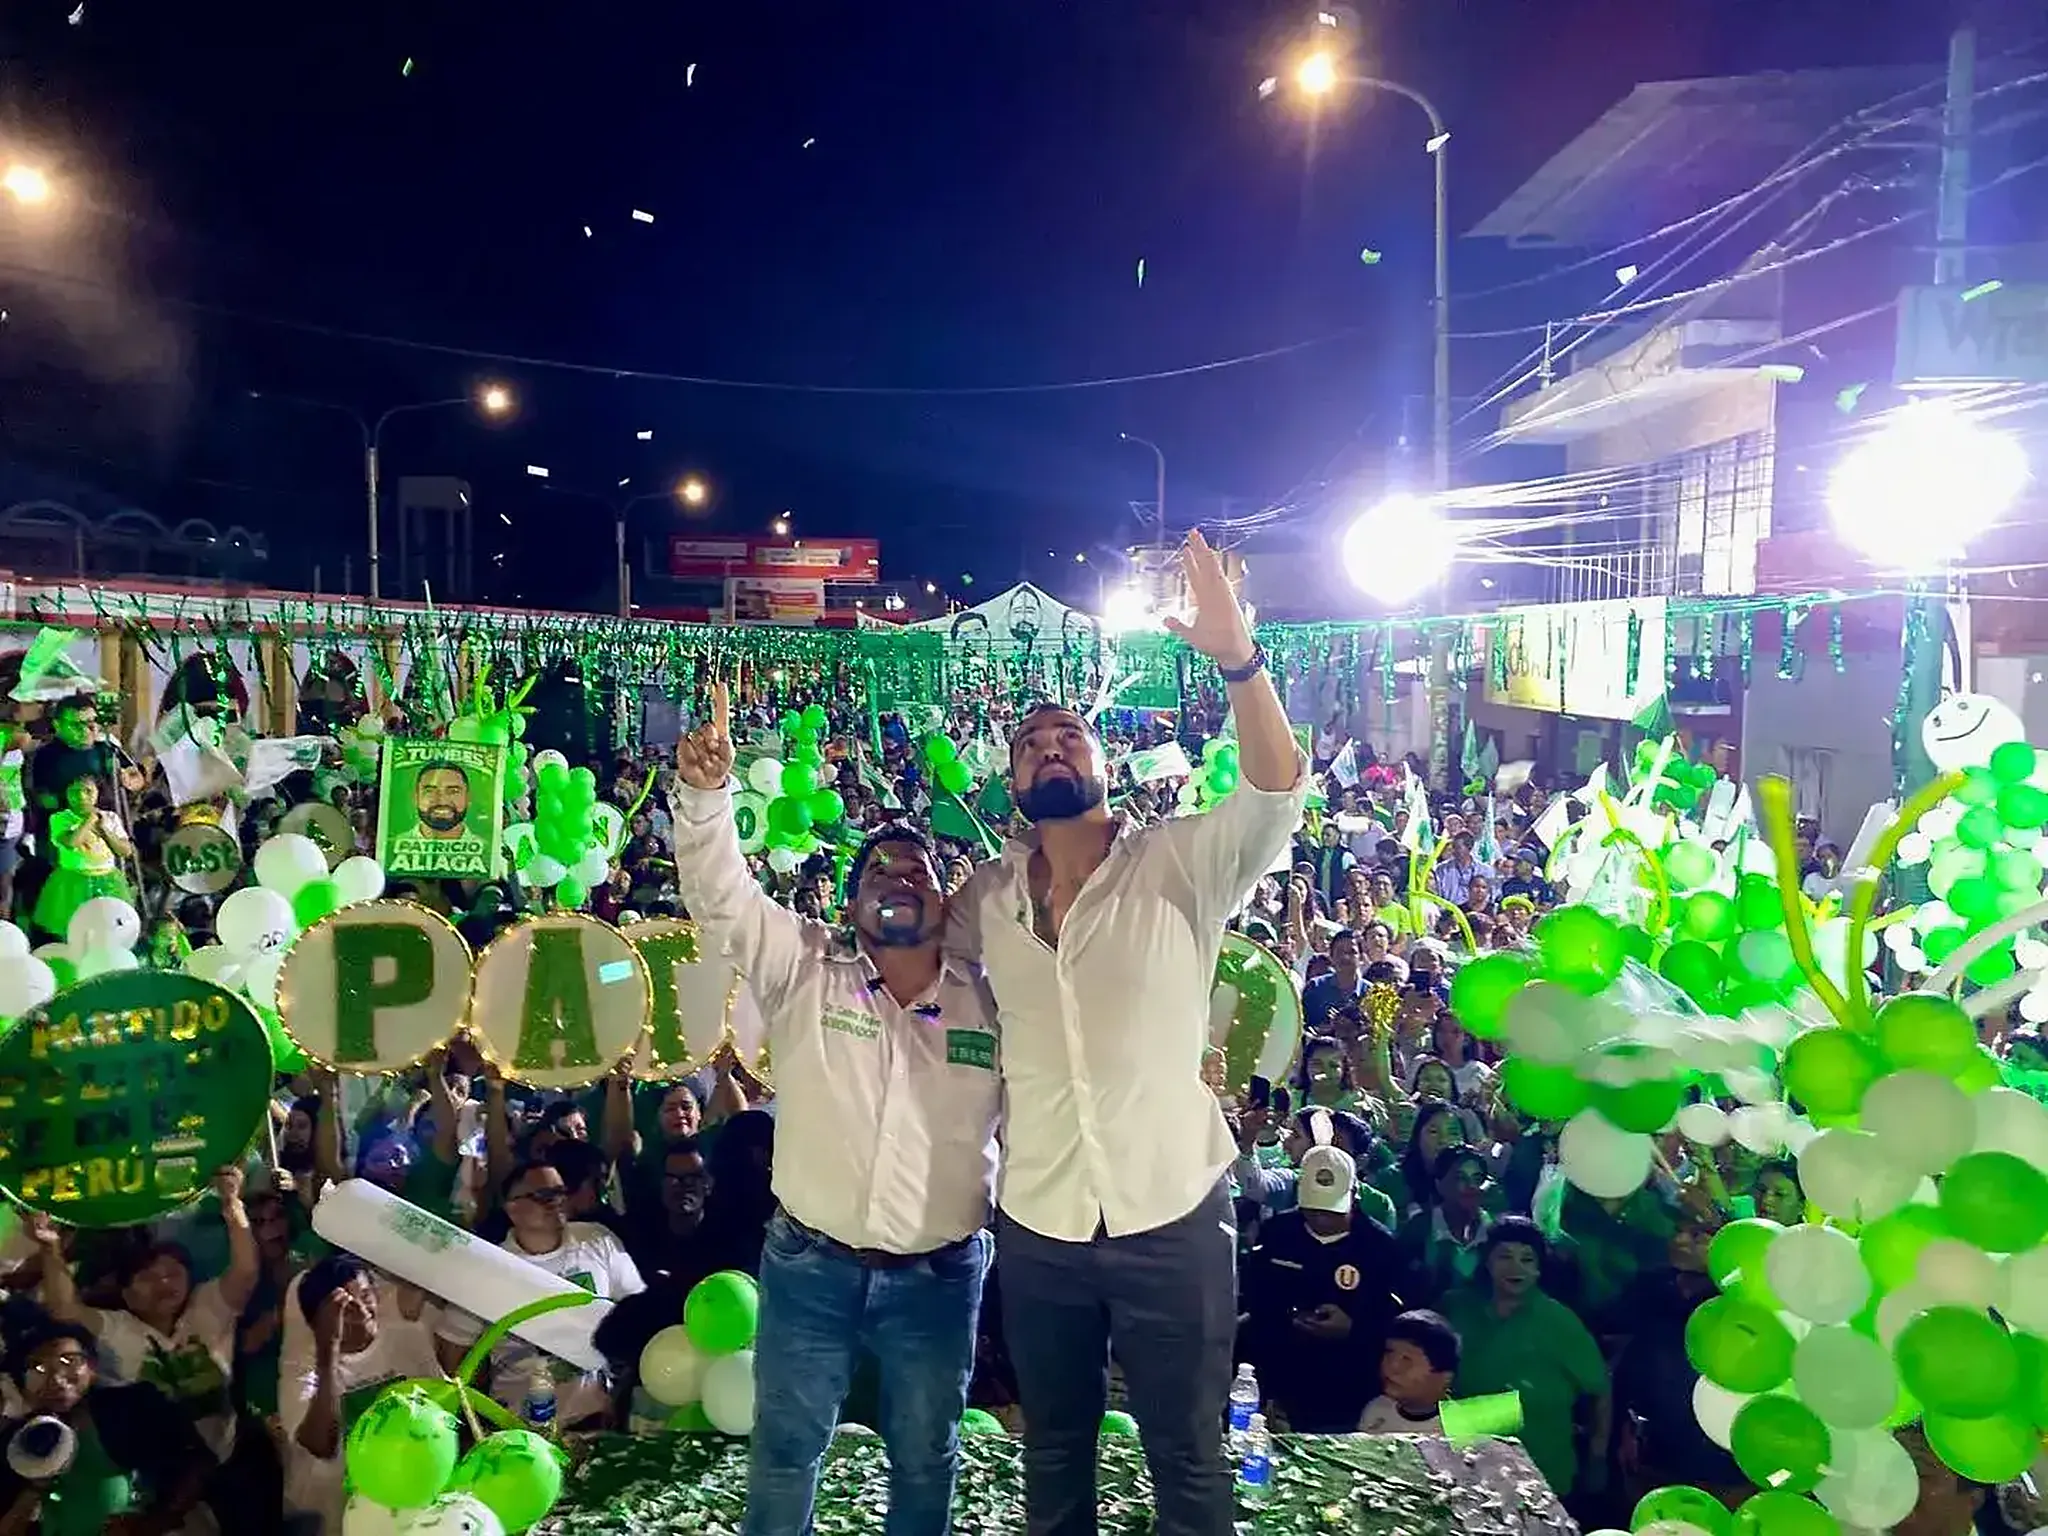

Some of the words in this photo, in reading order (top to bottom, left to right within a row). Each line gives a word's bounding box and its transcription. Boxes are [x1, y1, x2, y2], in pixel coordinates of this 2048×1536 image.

[408, 748, 485, 767] TUMBES
[399, 840, 482, 854] PATRICIO
[389, 853, 488, 873] ALIAGA
[30, 995, 230, 1059] PARTIDO
